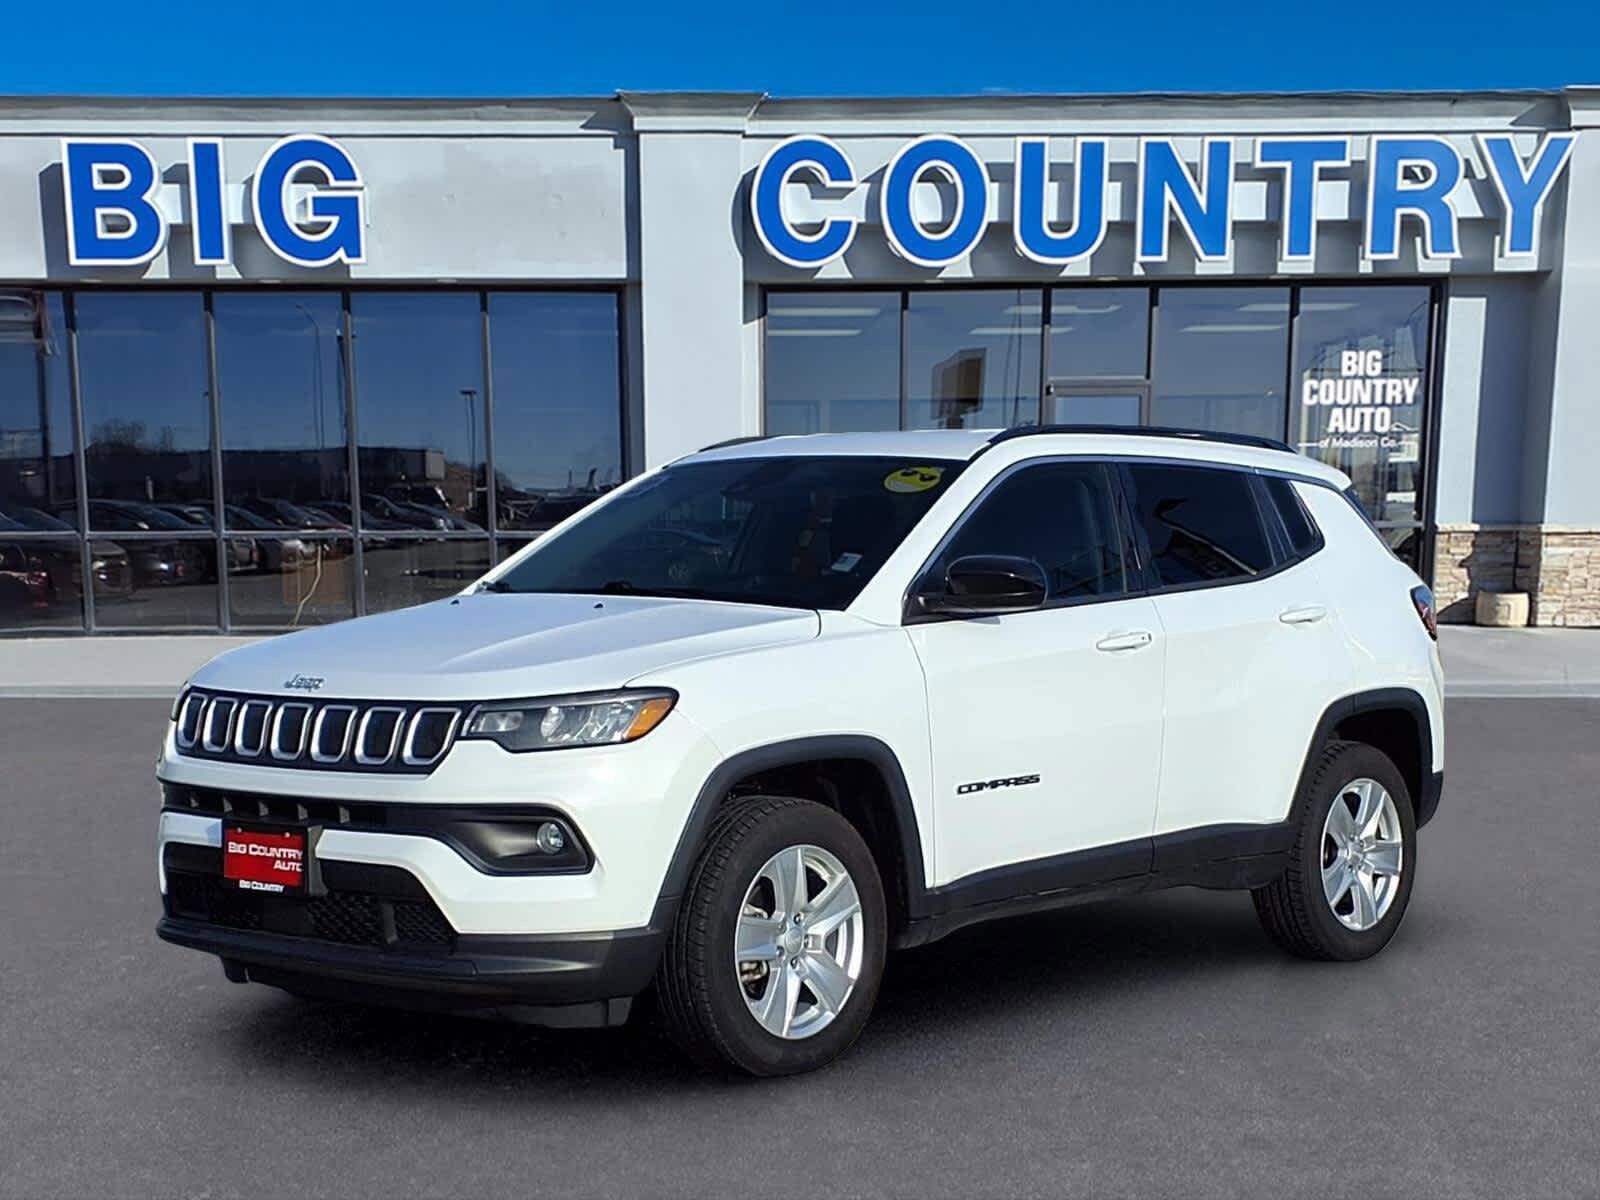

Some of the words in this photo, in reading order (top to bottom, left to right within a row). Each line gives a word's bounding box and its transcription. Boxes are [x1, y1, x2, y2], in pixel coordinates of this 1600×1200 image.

[60, 133, 367, 268] BIG
[750, 132, 1578, 269] COUNTRY
[1341, 350, 1382, 376] BIG
[1303, 378, 1419, 405] COUNTRY
[1327, 407, 1391, 433] AUTO
[284, 673, 324, 693] Jeep
[957, 773, 1040, 795] COMPASS
